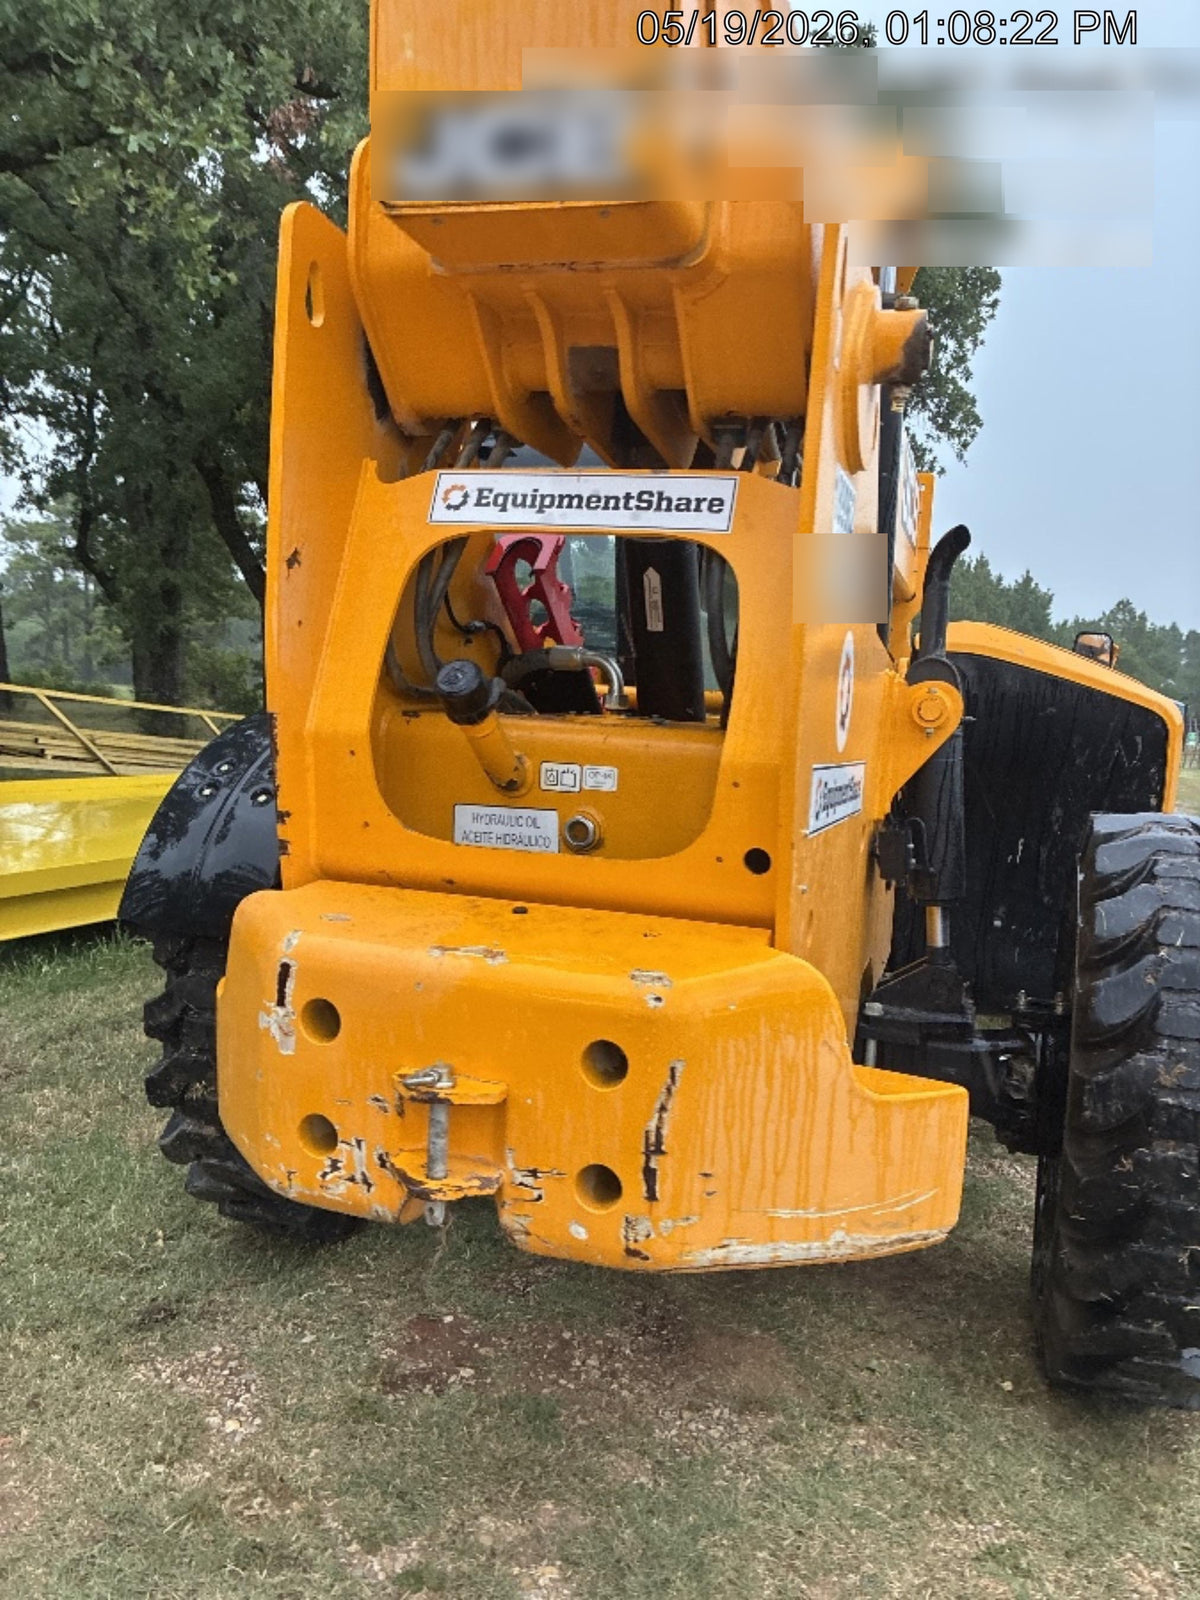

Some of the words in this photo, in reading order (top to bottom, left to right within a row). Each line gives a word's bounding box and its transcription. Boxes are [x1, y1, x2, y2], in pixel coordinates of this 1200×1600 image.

[473, 487, 725, 514] EquipmentShare
[471, 811, 523, 828] HYDRAULIC
[525, 815, 541, 830] OIL
[461, 829, 494, 844] ACEITE
